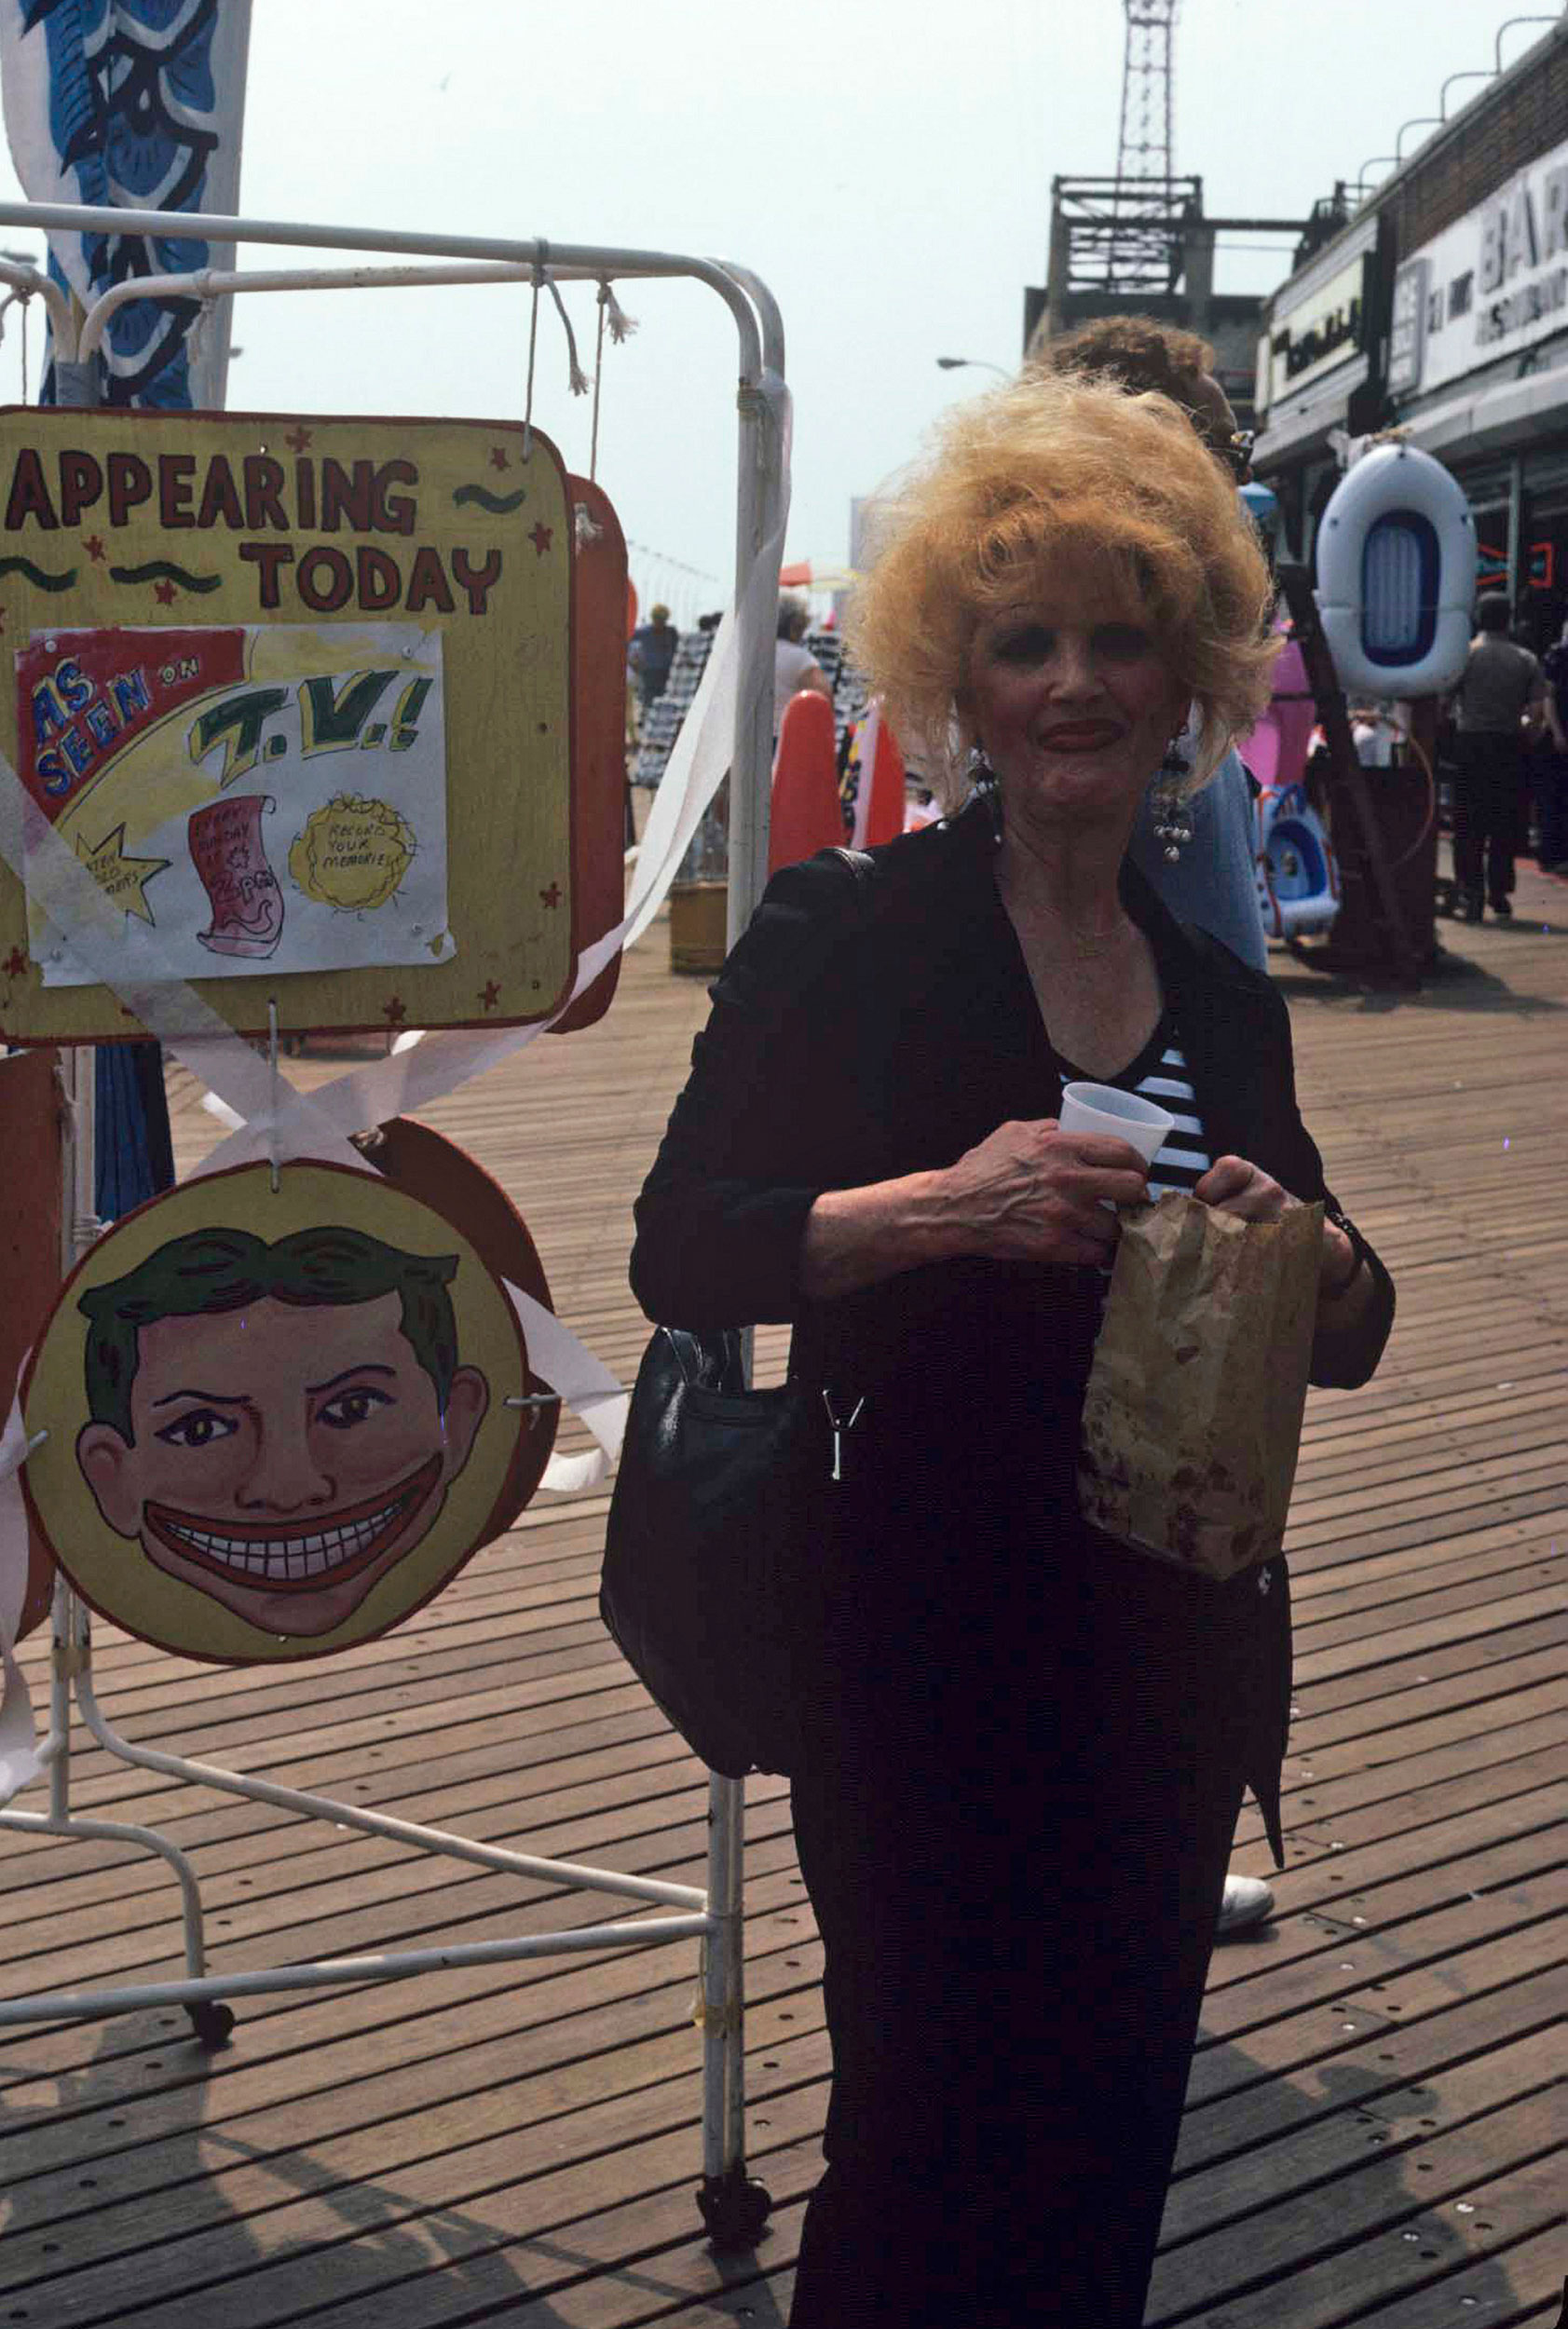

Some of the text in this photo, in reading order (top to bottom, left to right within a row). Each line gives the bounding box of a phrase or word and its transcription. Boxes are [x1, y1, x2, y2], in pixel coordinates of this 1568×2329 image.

[5, 448, 418, 536] APPEARING
[239, 542, 502, 615] TODAY
[33, 656, 96, 748] AS
[36, 656, 199, 797] SEEN ON
[328, 838, 369, 852] YOUR
